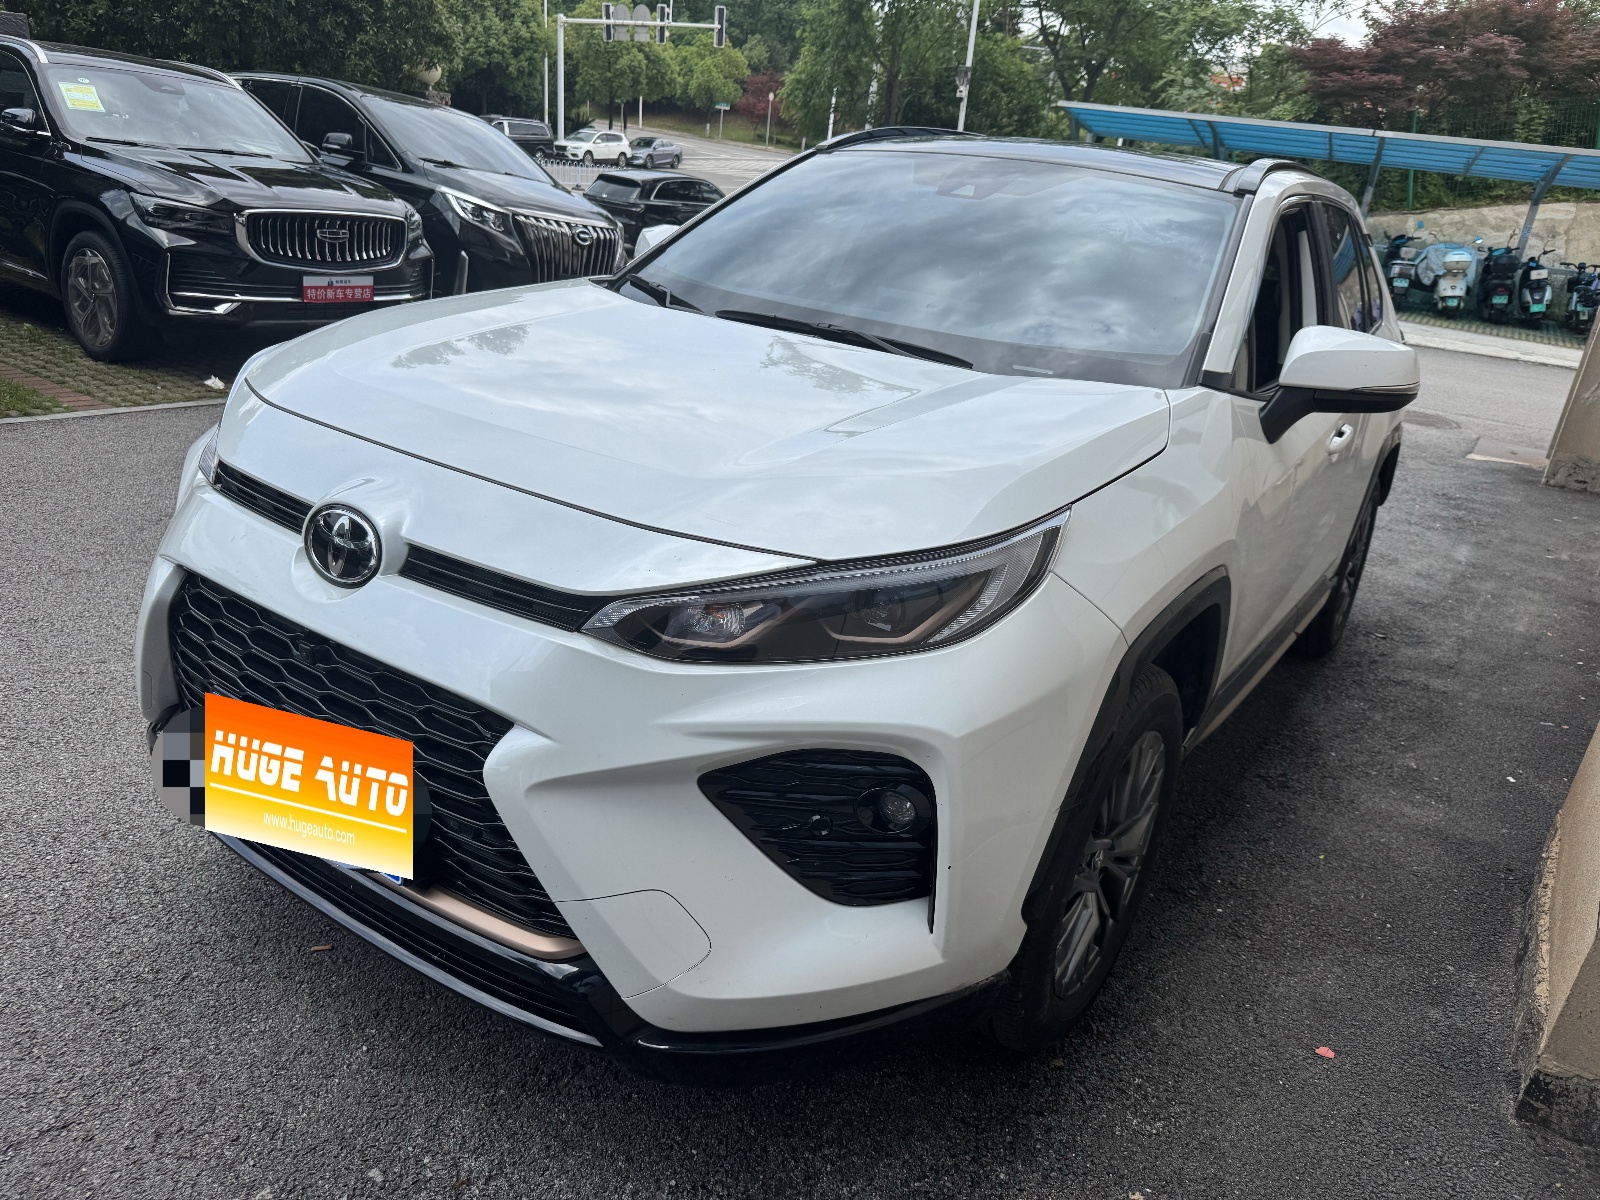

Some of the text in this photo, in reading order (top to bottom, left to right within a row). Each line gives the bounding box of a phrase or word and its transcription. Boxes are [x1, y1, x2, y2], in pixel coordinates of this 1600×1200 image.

[307, 288, 371, 299] 特价新车专营店
